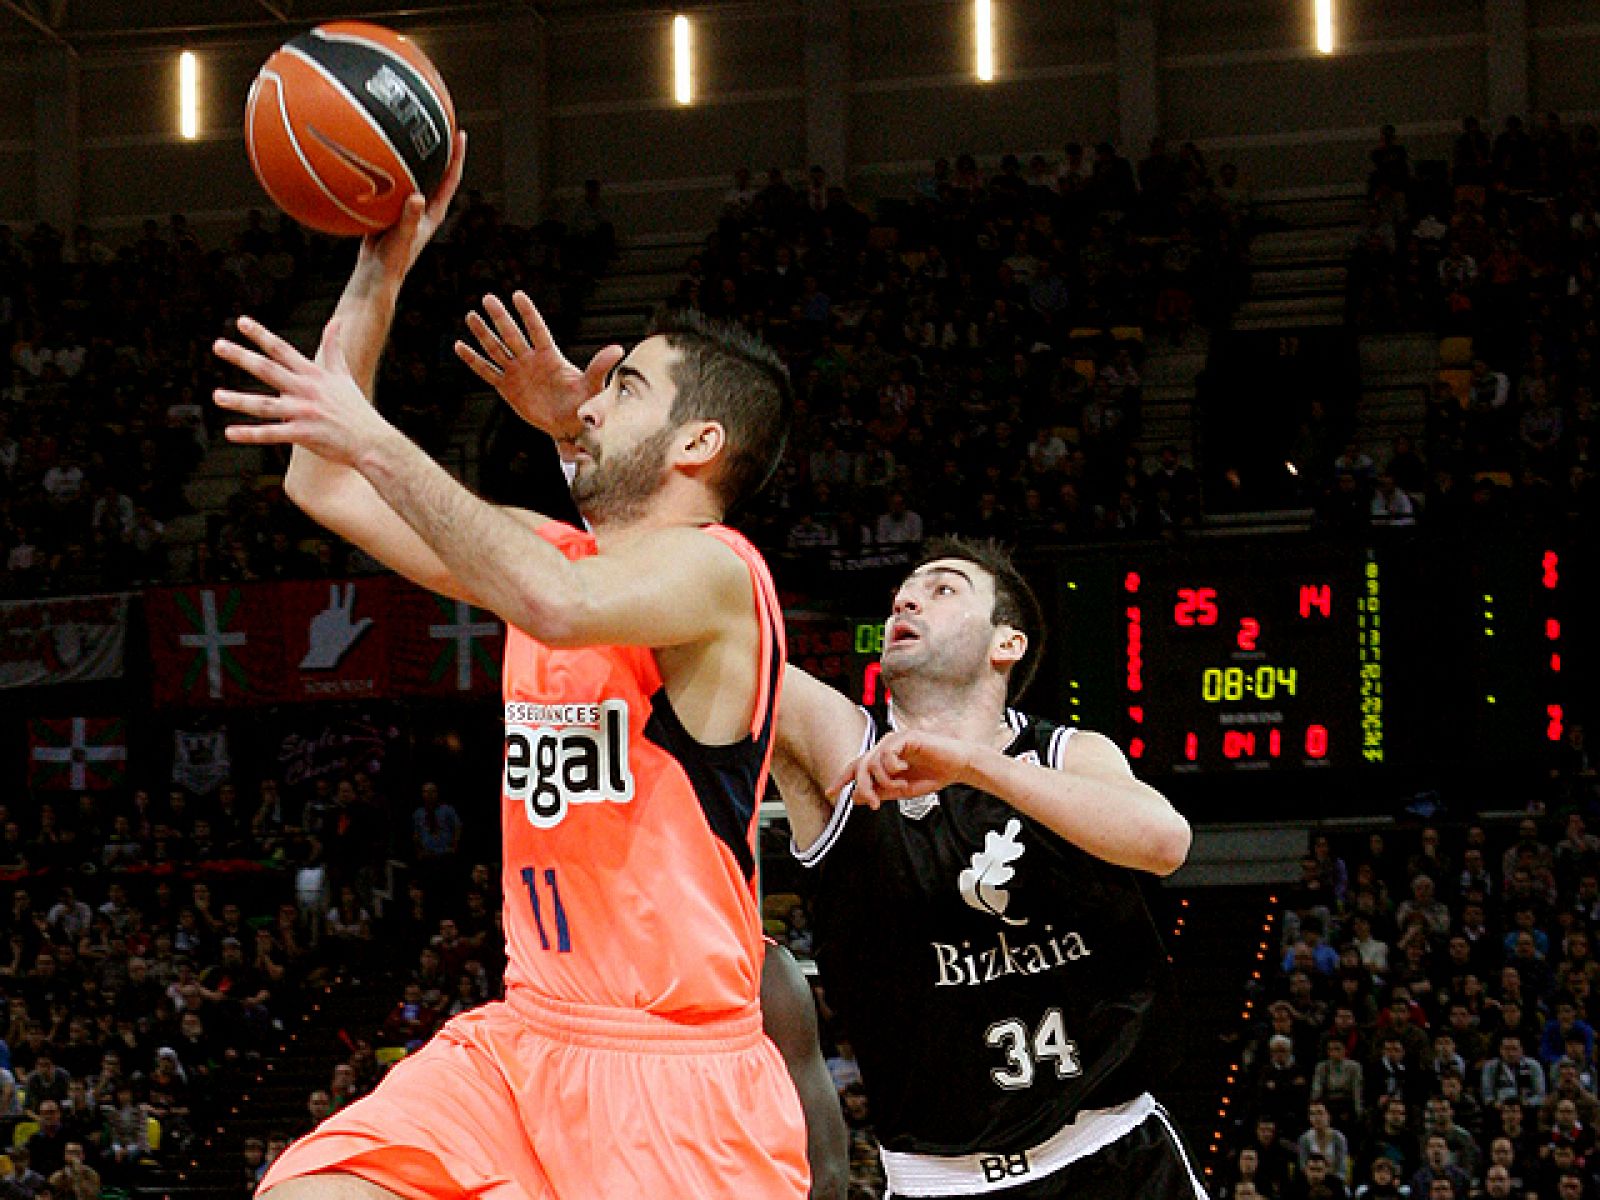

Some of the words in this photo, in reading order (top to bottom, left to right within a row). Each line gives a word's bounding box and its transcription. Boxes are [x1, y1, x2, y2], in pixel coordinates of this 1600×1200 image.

[1174, 587, 1218, 626] 25
[1299, 585, 1331, 618] 14
[1237, 617, 1260, 650] 2
[1202, 665, 1298, 702] 08:04
[1185, 731, 1198, 761] 1
[1305, 724, 1328, 758] 0
[505, 708, 626, 818] egal
[519, 866, 573, 953] 11
[930, 924, 1092, 987] Bizkaia
[984, 1006, 1083, 1090] 34
